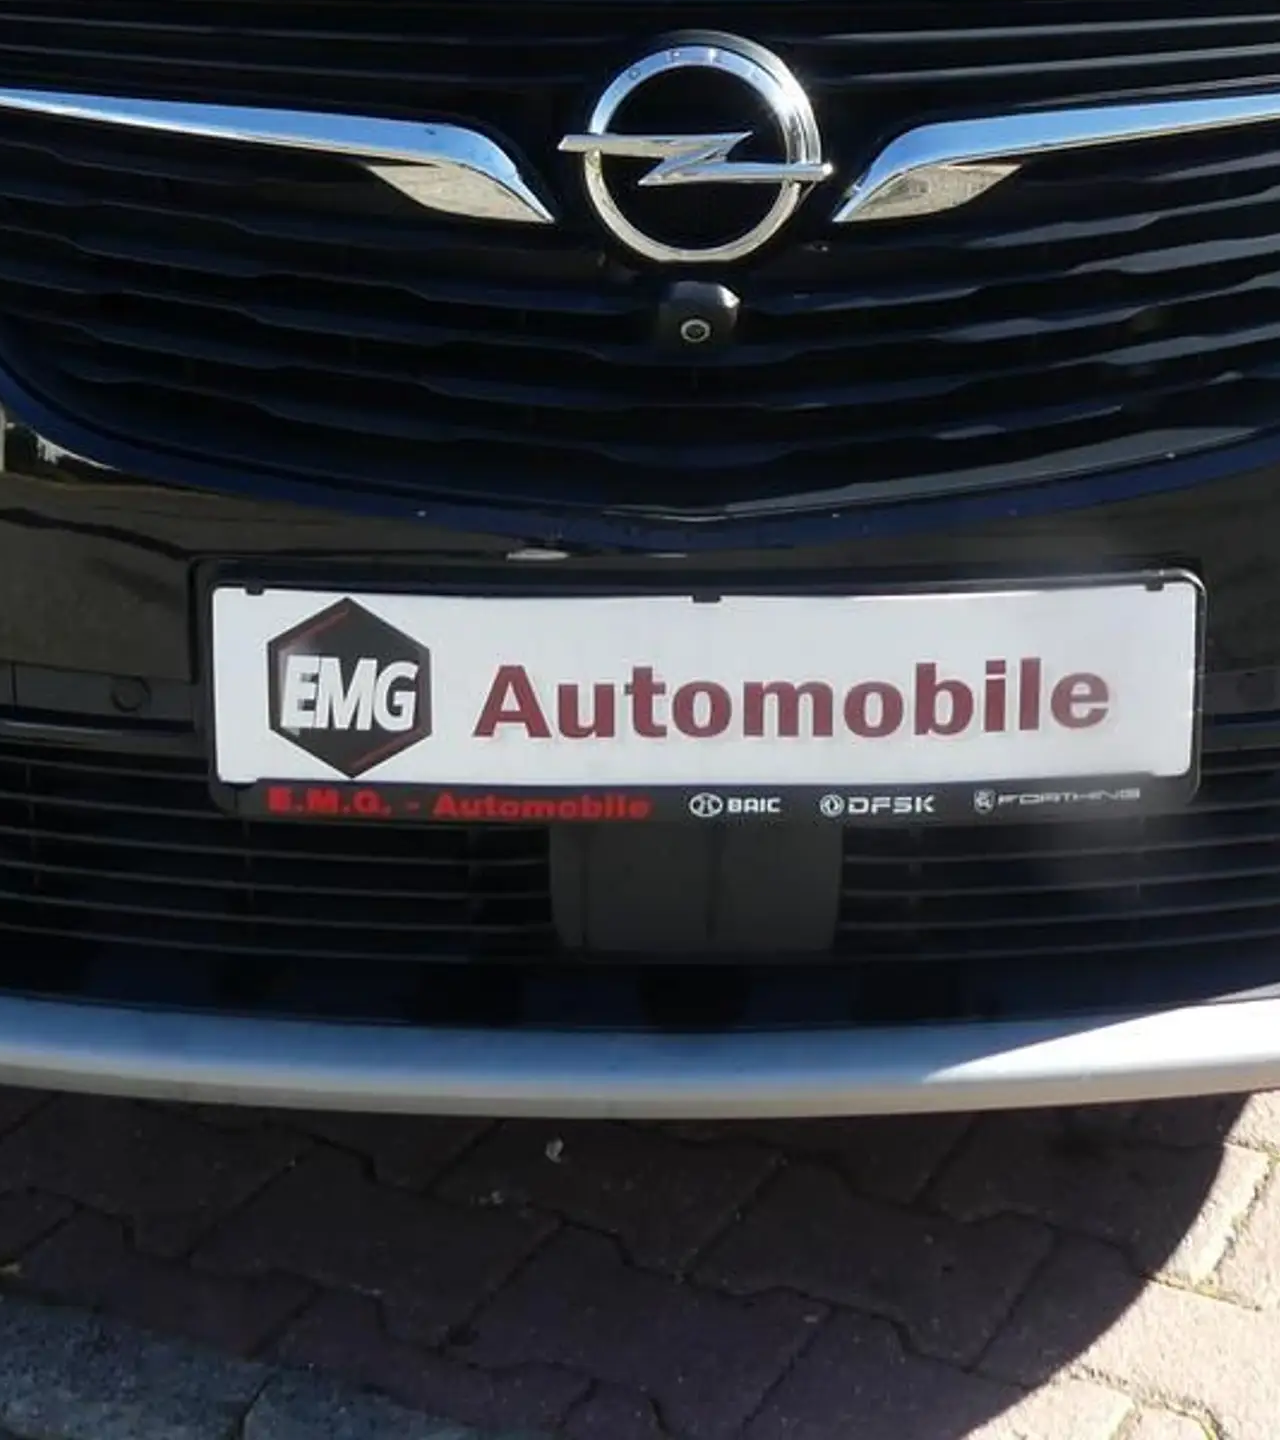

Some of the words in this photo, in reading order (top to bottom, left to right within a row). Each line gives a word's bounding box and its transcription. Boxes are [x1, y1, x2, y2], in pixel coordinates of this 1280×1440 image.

[280, 654, 419, 732] EMG
[472, 657, 1110, 739] Automobile
[432, 791, 652, 820] Automobile
[727, 798, 782, 814] BAIC
[848, 794, 937, 814] DFSK
